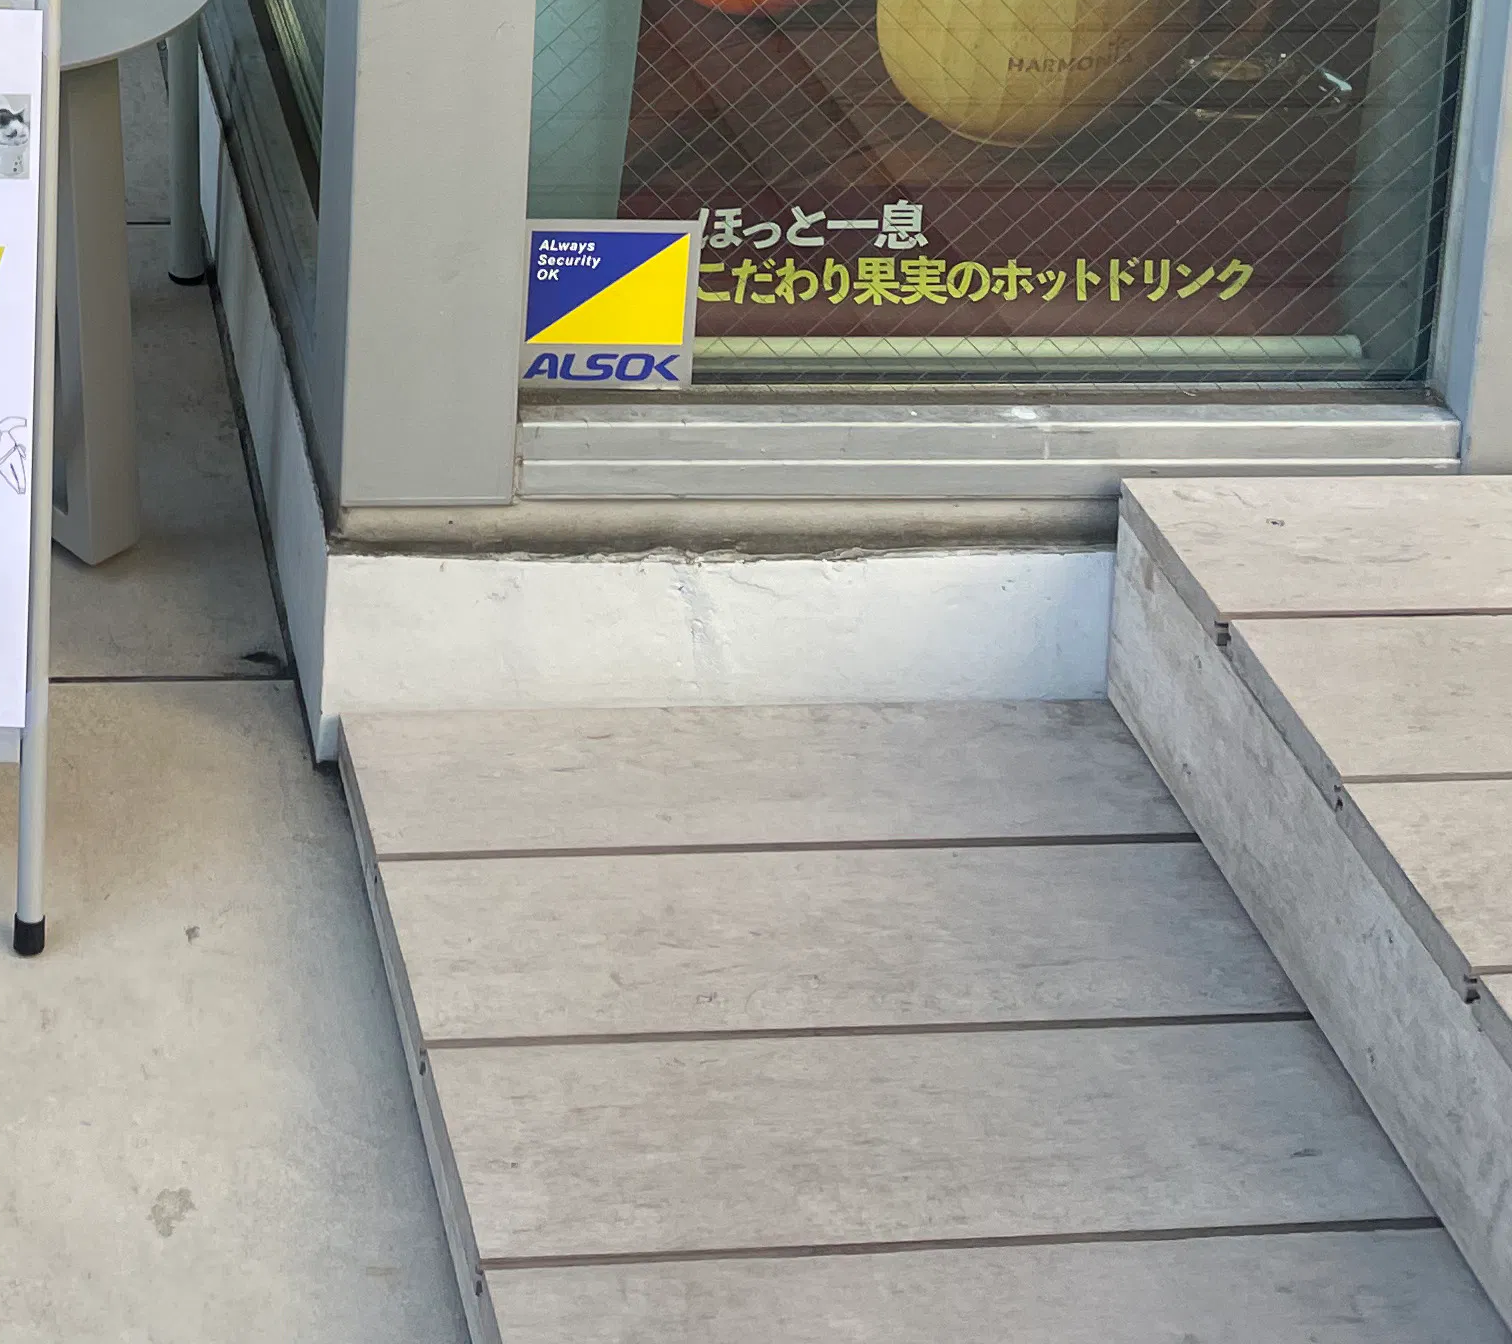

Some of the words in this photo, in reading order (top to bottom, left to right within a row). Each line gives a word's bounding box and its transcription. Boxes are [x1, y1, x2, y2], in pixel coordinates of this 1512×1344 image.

[699, 199, 929, 250] ほっと一息
[538, 239, 596, 254] ALways
[537, 254, 601, 269] Security
[536, 269, 560, 281] OK
[697, 255, 1255, 306] こだわり果実のホットドリンク
[523, 352, 681, 381] ALSOK
